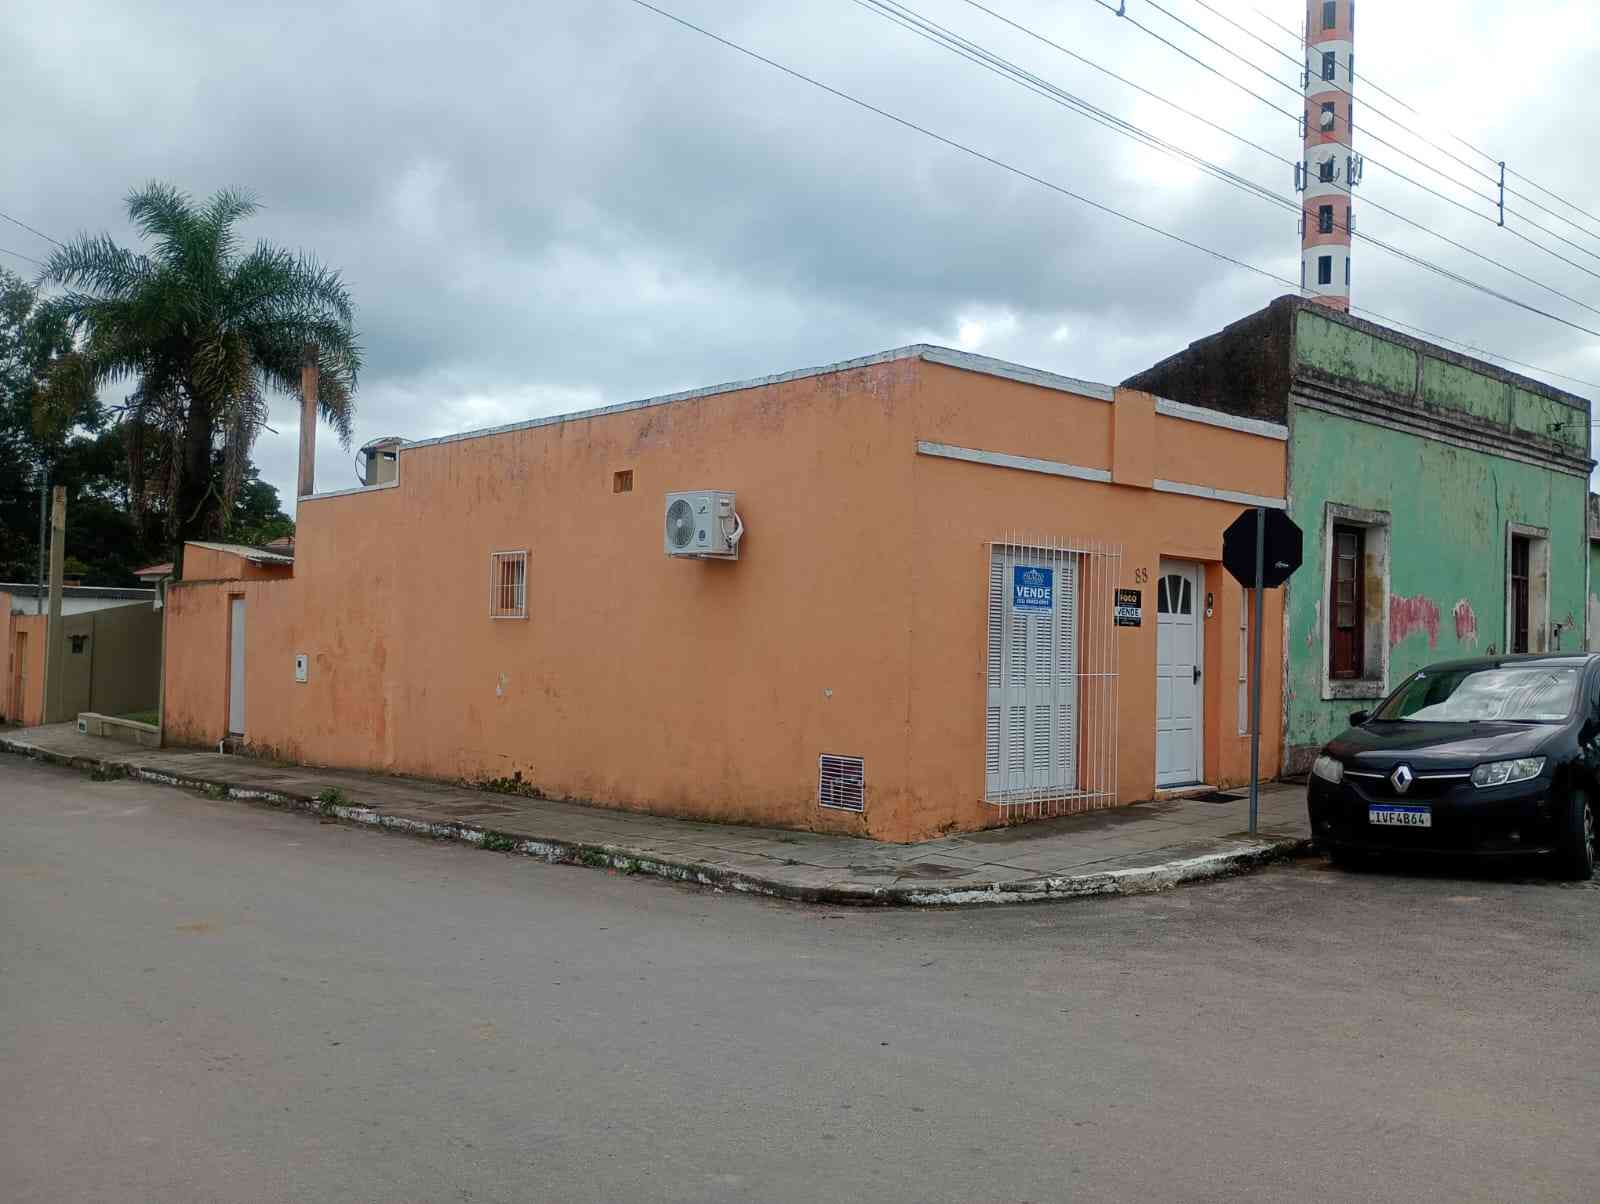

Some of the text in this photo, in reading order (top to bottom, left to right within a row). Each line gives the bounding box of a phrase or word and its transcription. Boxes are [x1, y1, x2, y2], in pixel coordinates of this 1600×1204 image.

[1016, 585, 1051, 599] VENDE
[1117, 607, 1139, 617] VENDE
[1375, 811, 1425, 825] IVF4B64
